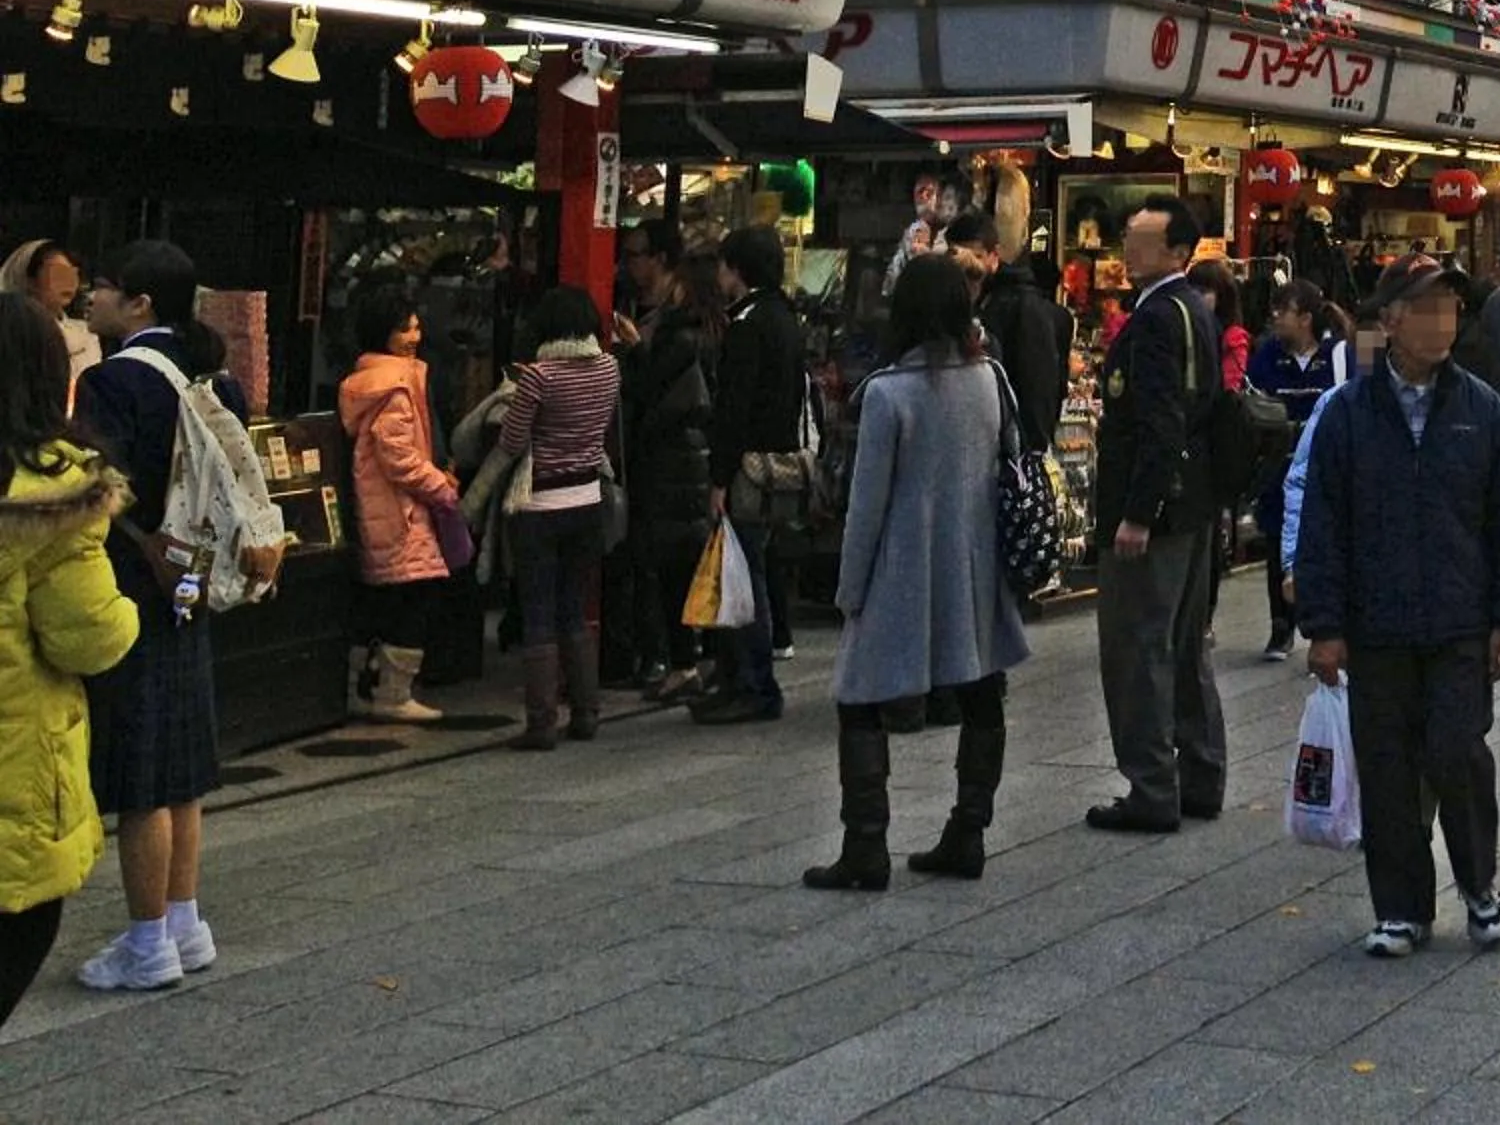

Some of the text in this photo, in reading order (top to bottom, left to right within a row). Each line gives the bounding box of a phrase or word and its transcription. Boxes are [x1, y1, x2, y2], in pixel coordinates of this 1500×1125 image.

[1218, 30, 1373, 97] コマチヘア
